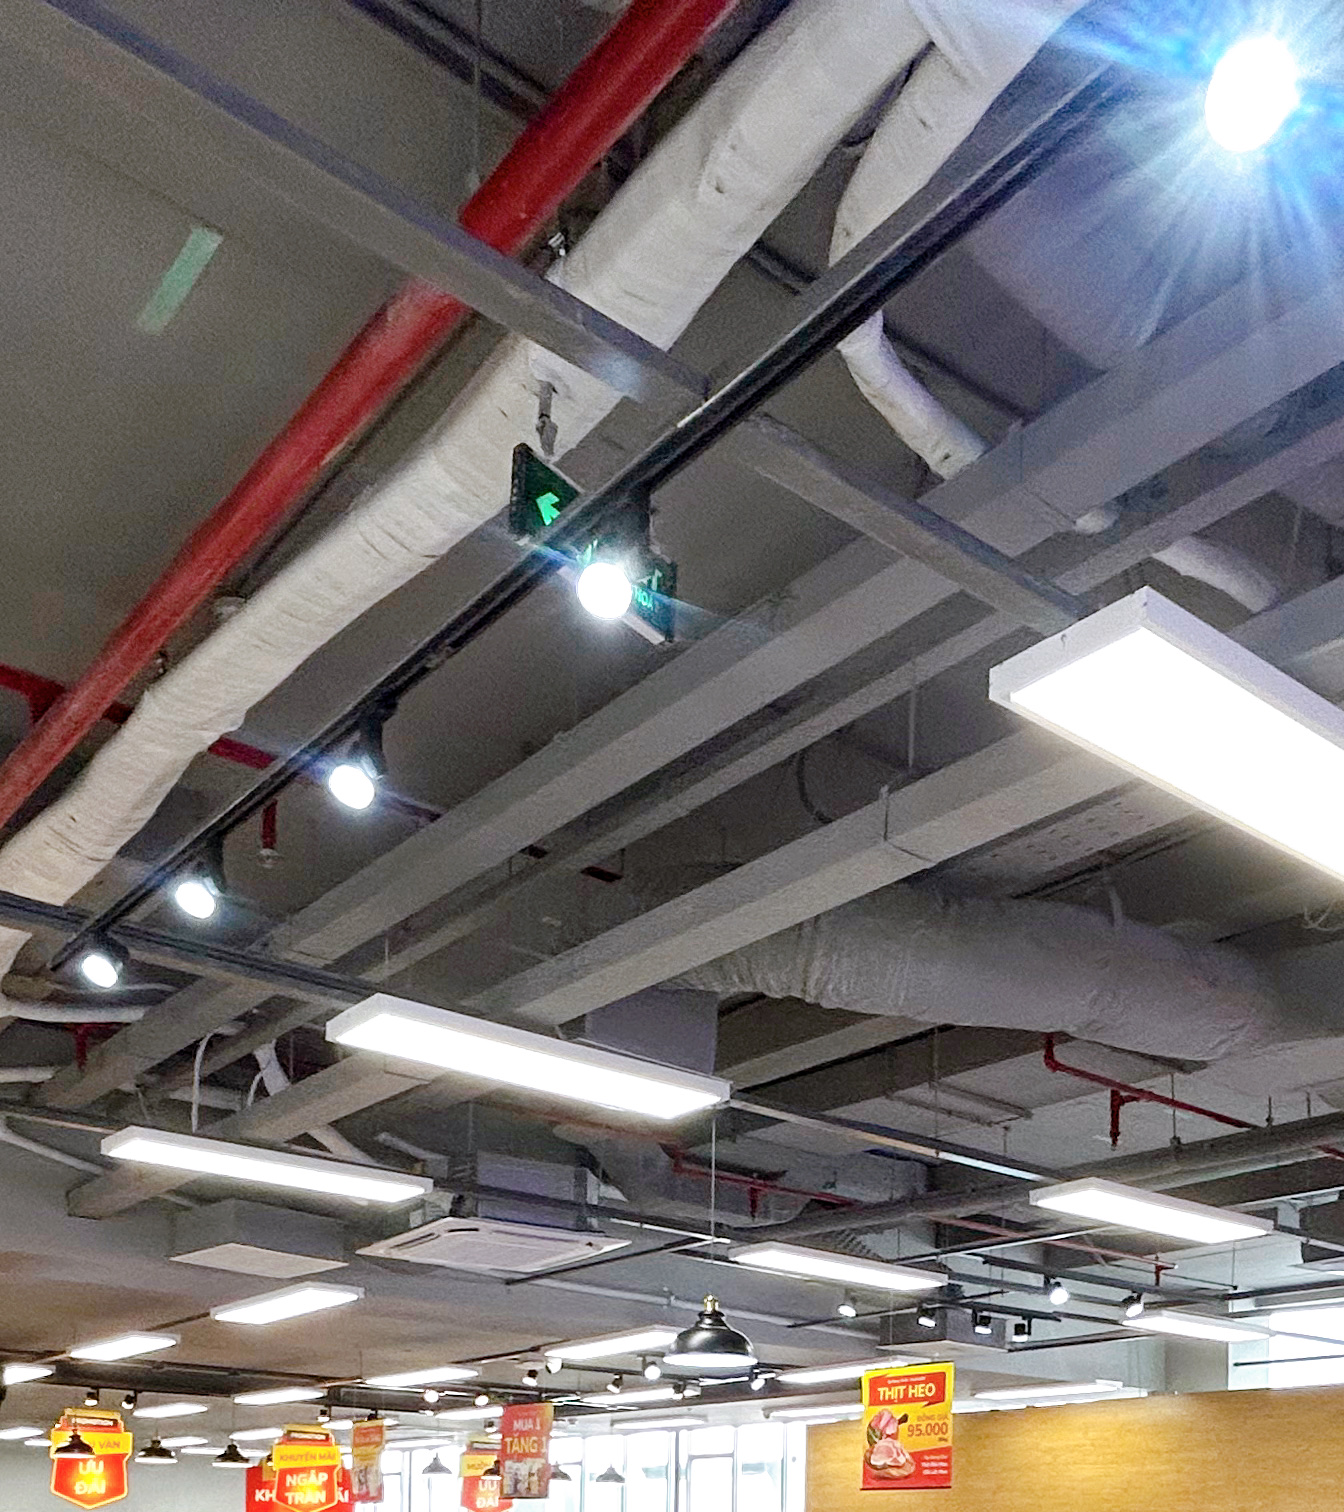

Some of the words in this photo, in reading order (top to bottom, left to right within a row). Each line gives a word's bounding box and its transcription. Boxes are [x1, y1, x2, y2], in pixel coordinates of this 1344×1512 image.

[878, 1385, 907, 1403] THỊT
[908, 1383, 936, 1398] HEO
[907, 1422, 949, 1437] 95.000
